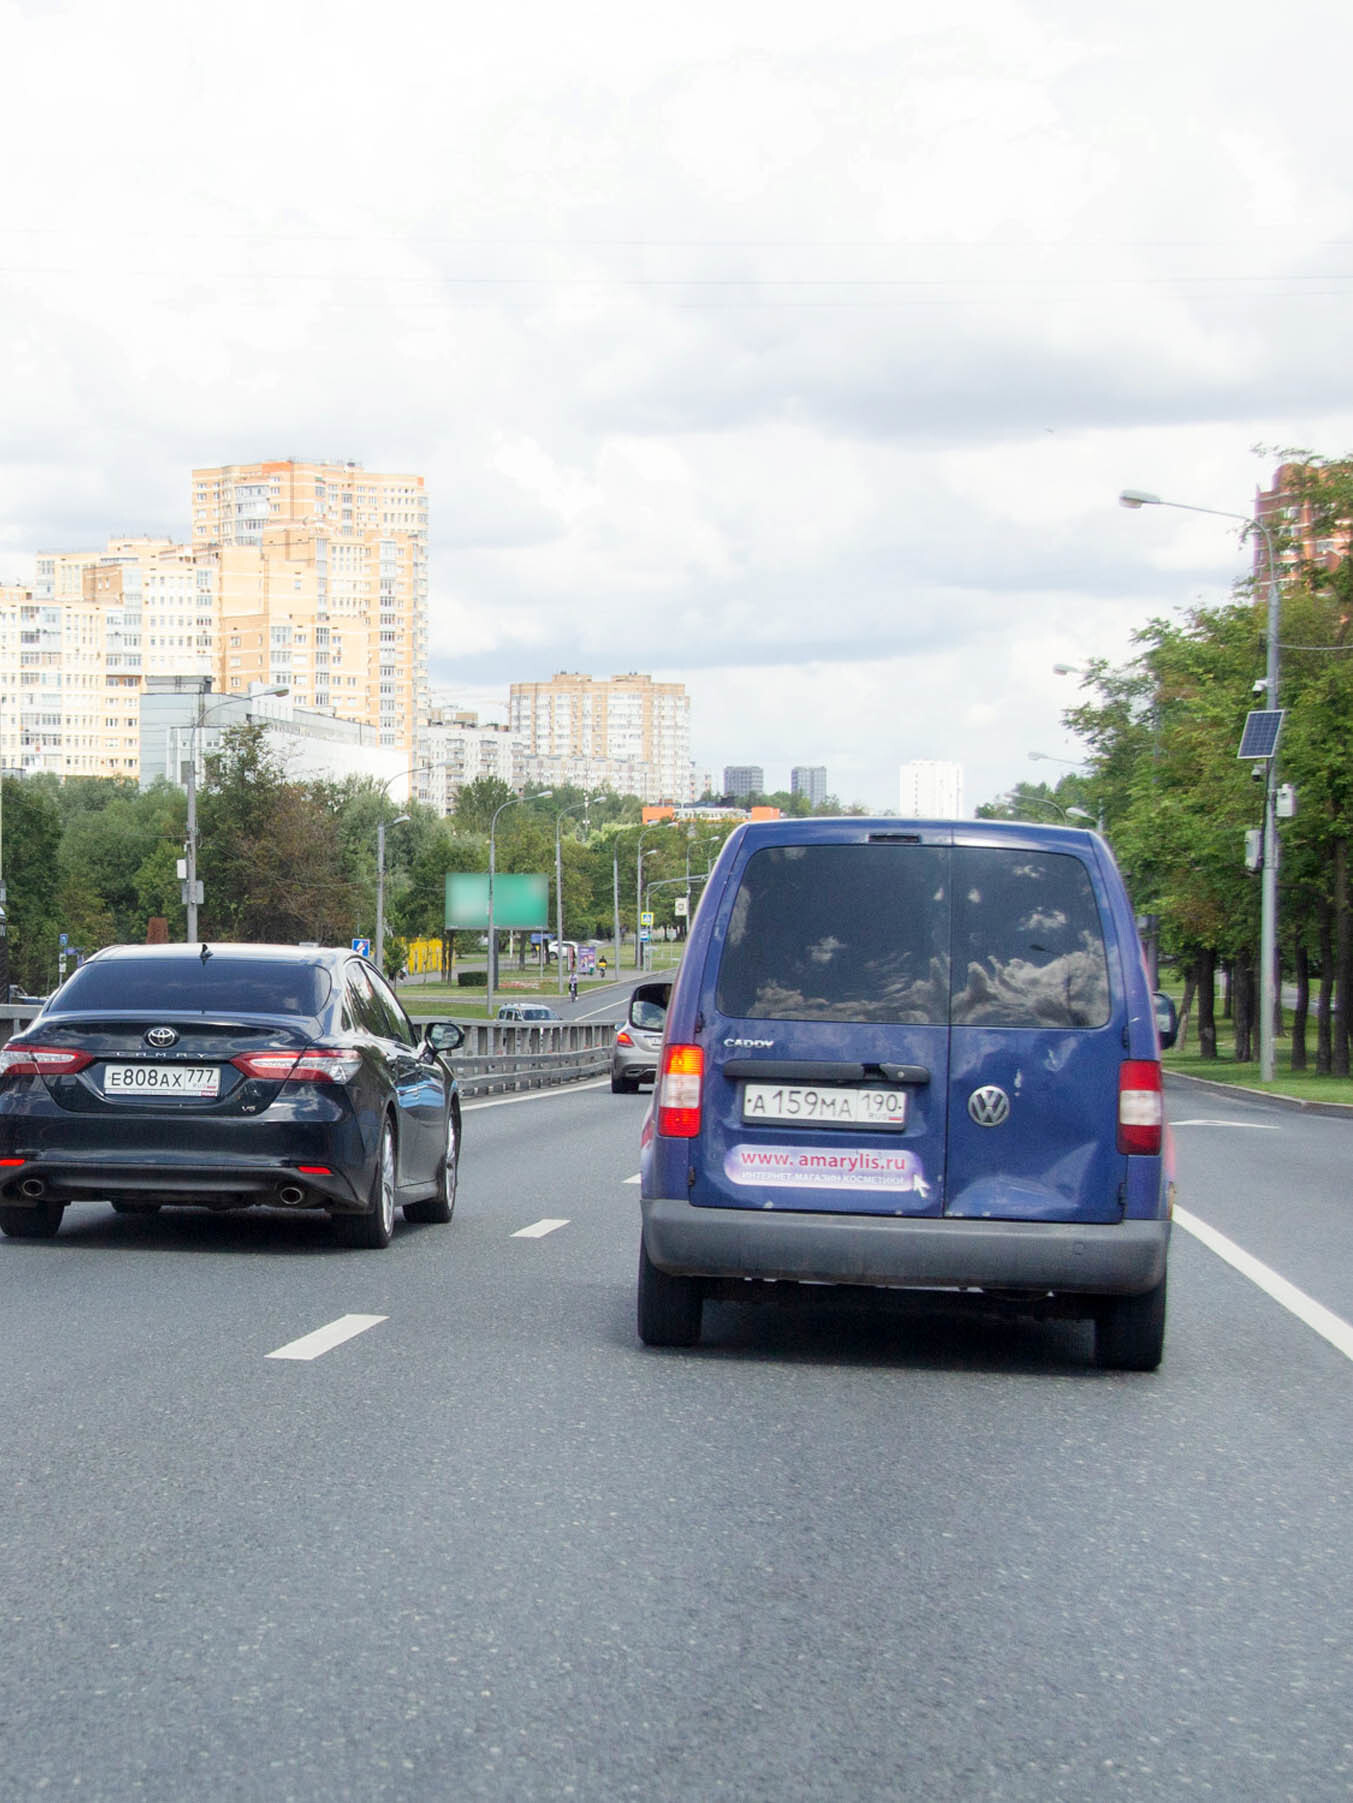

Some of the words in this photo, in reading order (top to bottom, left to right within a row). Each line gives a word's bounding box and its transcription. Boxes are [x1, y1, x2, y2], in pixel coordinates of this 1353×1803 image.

[723, 1038, 775, 1048] CADDY
[187, 1069, 215, 1083] 777
[862, 1093, 898, 1112] 190
[799, 1153, 906, 1172] amarylis.ru
